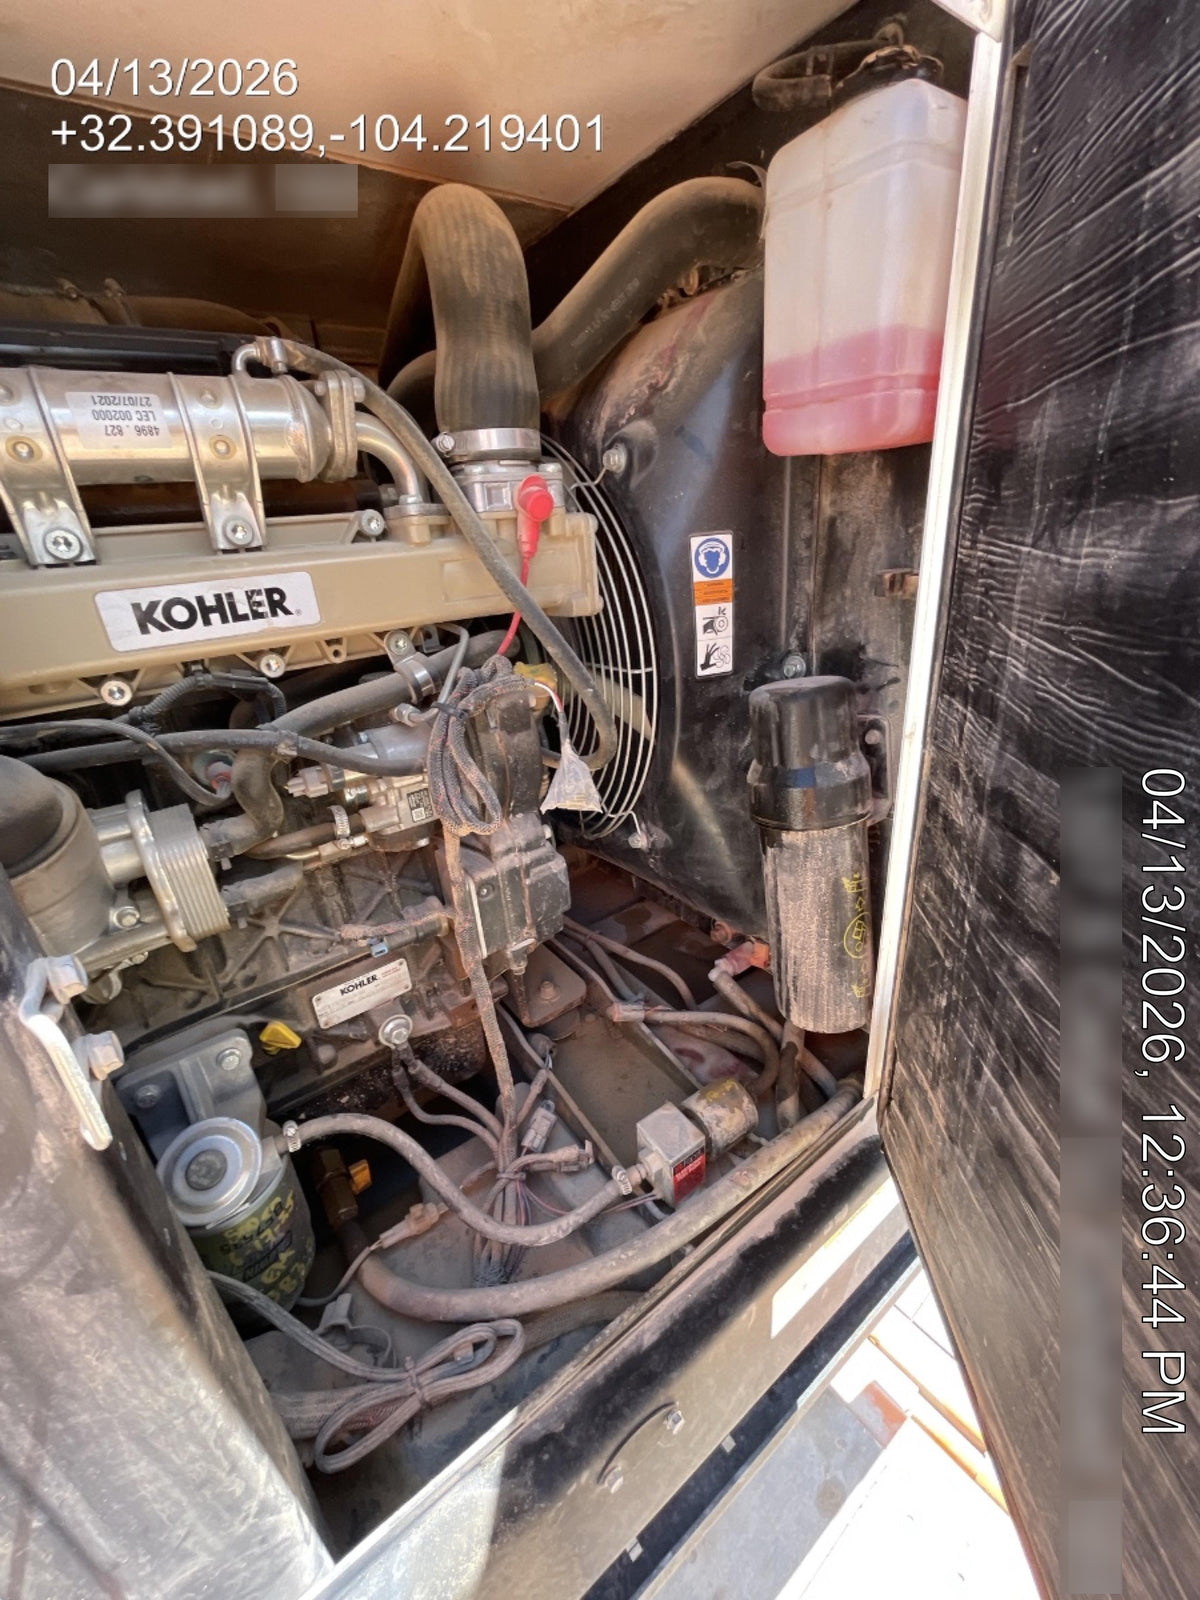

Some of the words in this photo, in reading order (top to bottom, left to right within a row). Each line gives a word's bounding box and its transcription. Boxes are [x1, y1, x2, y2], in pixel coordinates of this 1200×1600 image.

[90, 395, 152, 407] 27/07/2021
[91, 409, 132, 421] 002000
[136, 411, 157, 421] LEC
[134, 425, 160, 436] 4896
[131, 587, 293, 635] KOHLER
[339, 974, 378, 996] KOHLER
